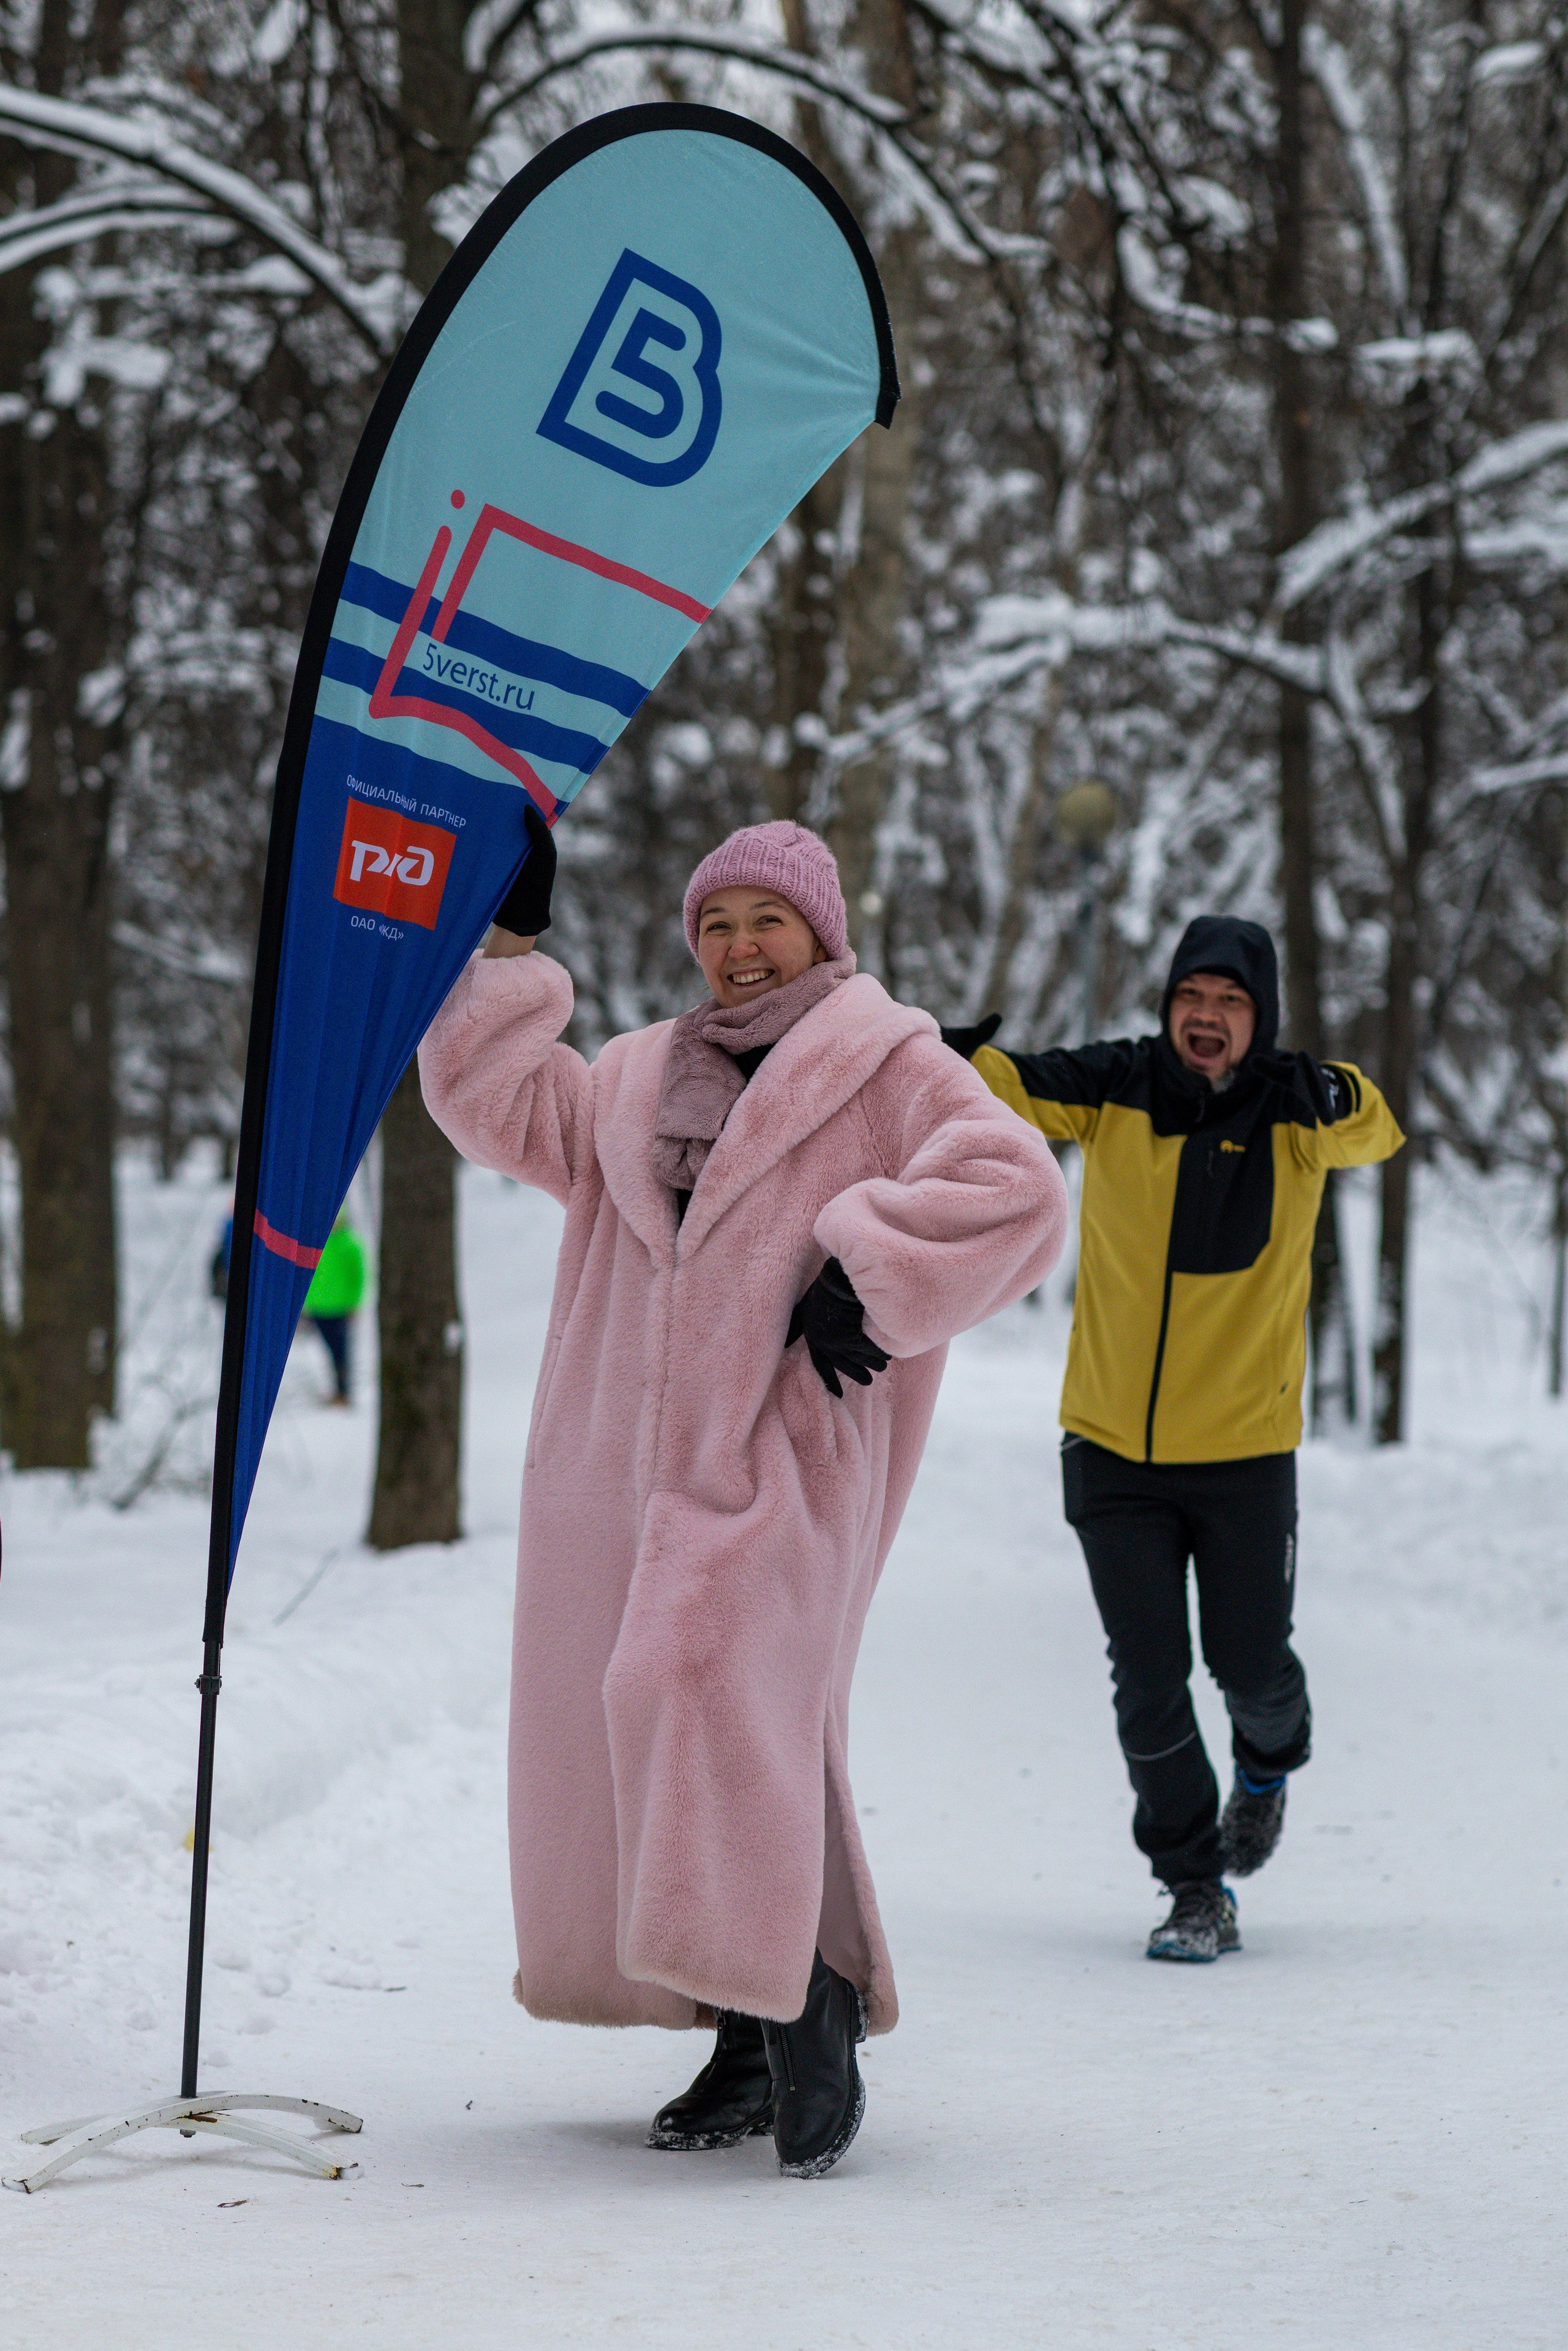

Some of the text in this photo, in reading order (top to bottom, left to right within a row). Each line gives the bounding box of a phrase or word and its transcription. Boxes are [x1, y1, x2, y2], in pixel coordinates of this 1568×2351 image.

[423, 643, 535, 711] 5verst.ru
[347, 774, 466, 828] ОФИЦИАЛЬНЫЙ ПАРТНЕР
[351, 916, 375, 930] ОАО
